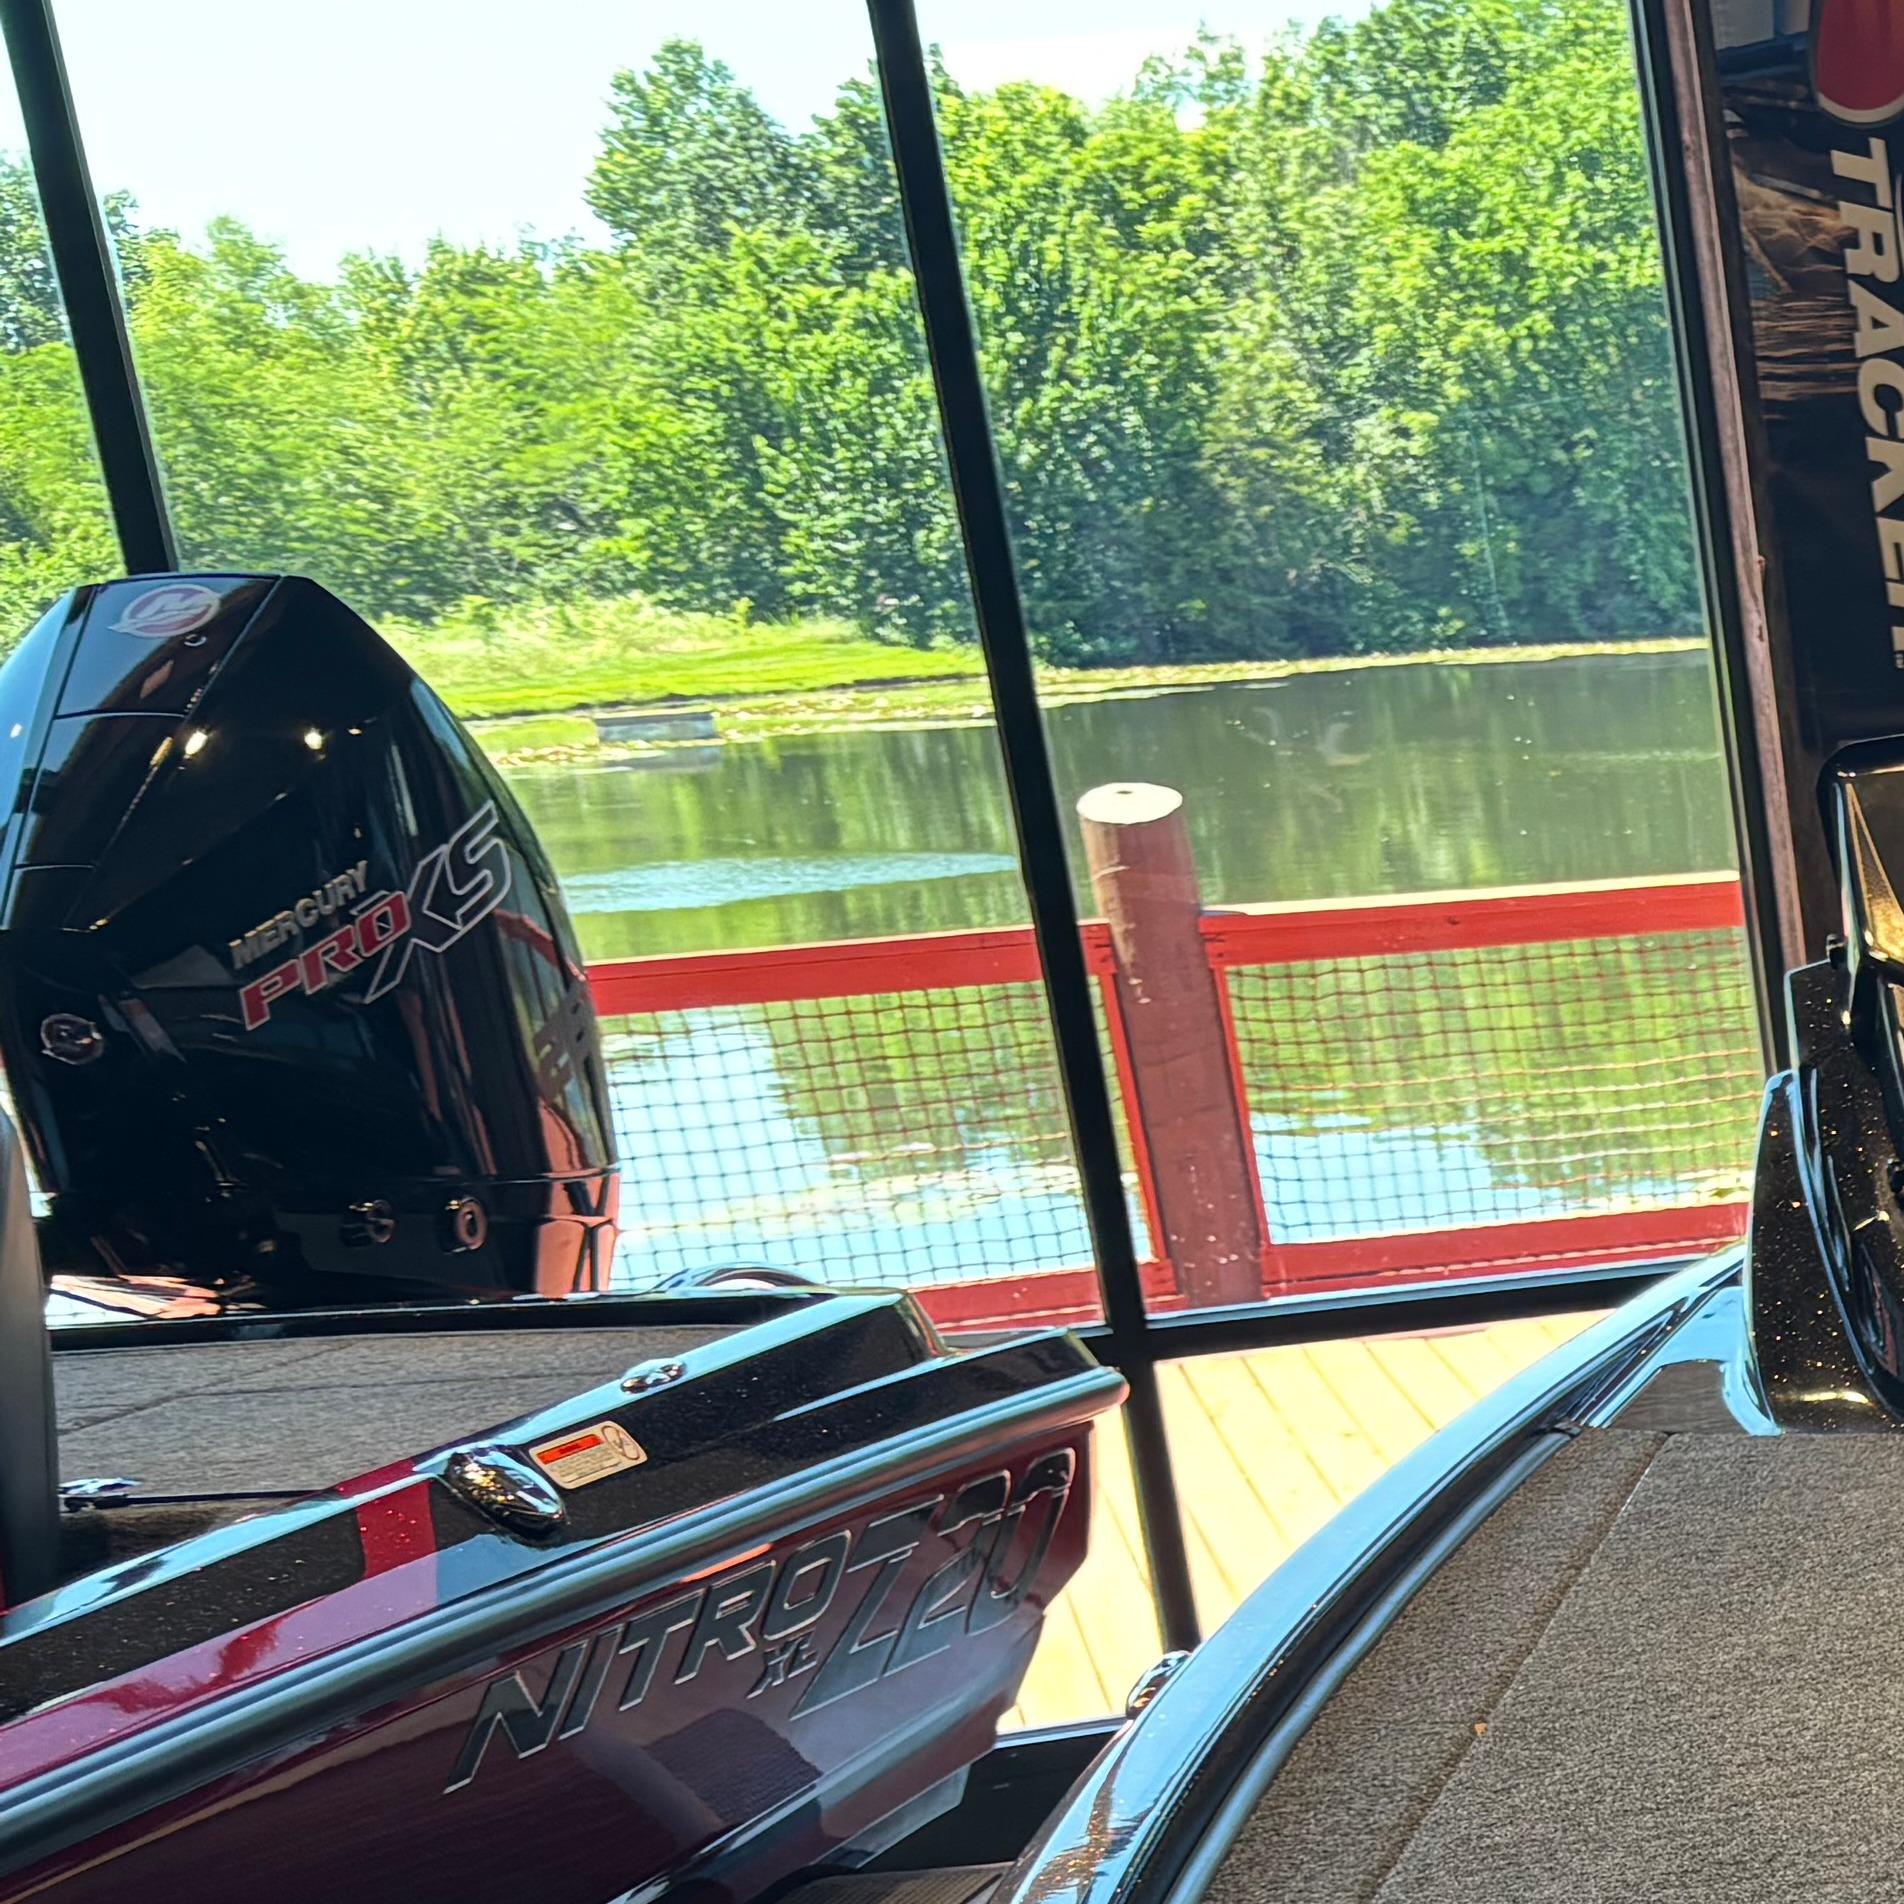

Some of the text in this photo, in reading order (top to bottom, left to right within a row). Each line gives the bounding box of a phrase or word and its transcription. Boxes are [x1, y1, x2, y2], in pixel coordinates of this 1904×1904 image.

[228, 860, 368, 970] MERCURY
[239, 891, 411, 1031] PRO
[443, 1530, 852, 1794] NITRO
